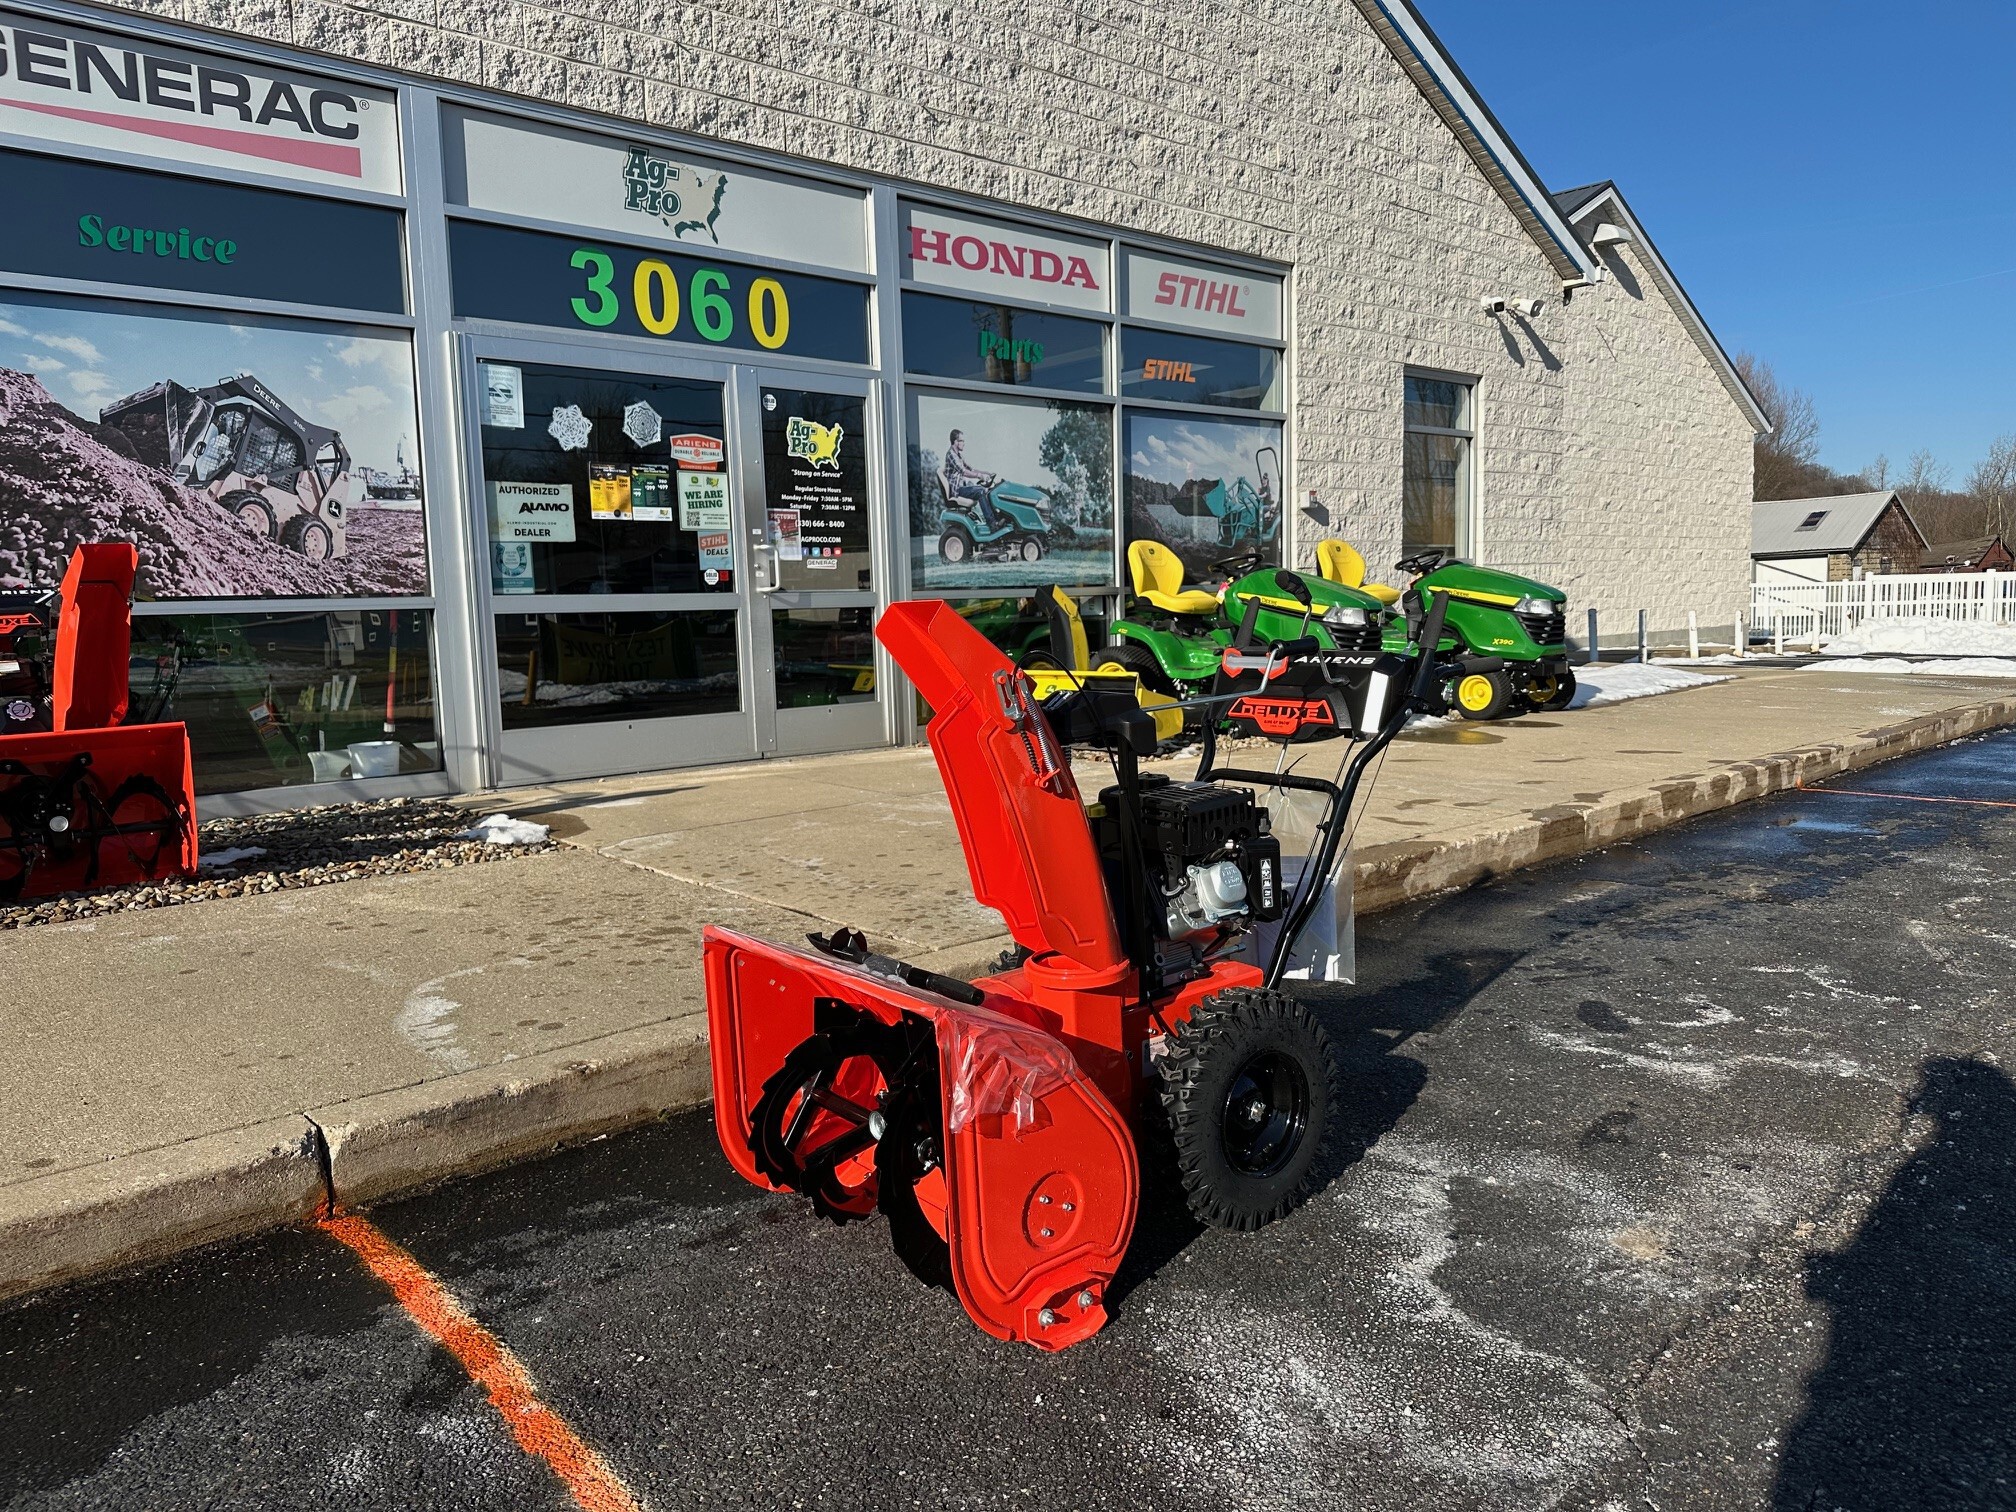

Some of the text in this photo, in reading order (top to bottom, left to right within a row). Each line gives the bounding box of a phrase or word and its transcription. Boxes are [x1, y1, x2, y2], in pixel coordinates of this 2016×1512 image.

[0, 28, 359, 141] ENERAC
[625, 146, 679, 189] Ag-
[624, 178, 681, 215] Pro
[78, 213, 238, 265] Service
[907, 225, 1100, 291] HONDA
[570, 246, 791, 350] 3060
[1155, 271, 1247, 318] STIHL
[979, 329, 1045, 365] Parts
[1143, 358, 1197, 384] STIHL
[253, 384, 282, 411] DEERE
[790, 420, 817, 441] Ag-
[675, 439, 717, 448] ARIENS
[790, 437, 817, 454] Pro
[499, 485, 560, 496] AUTHORIZED
[684, 490, 724, 500] WE ARE
[794, 485, 814, 493] Regular
[518, 502, 570, 515] ALAMO
[687, 499, 723, 510] HIRING
[789, 503, 812, 511] Saturday
[812, 520, 825, 528] 666
[828, 520, 846, 528] 8400
[514, 528, 551, 537] DEALER
[701, 535, 727, 548] STIHL
[706, 548, 729, 556] DEALS
[1293, 656, 1376, 665] ARIENS
[1241, 704, 1319, 720] DELUXE
